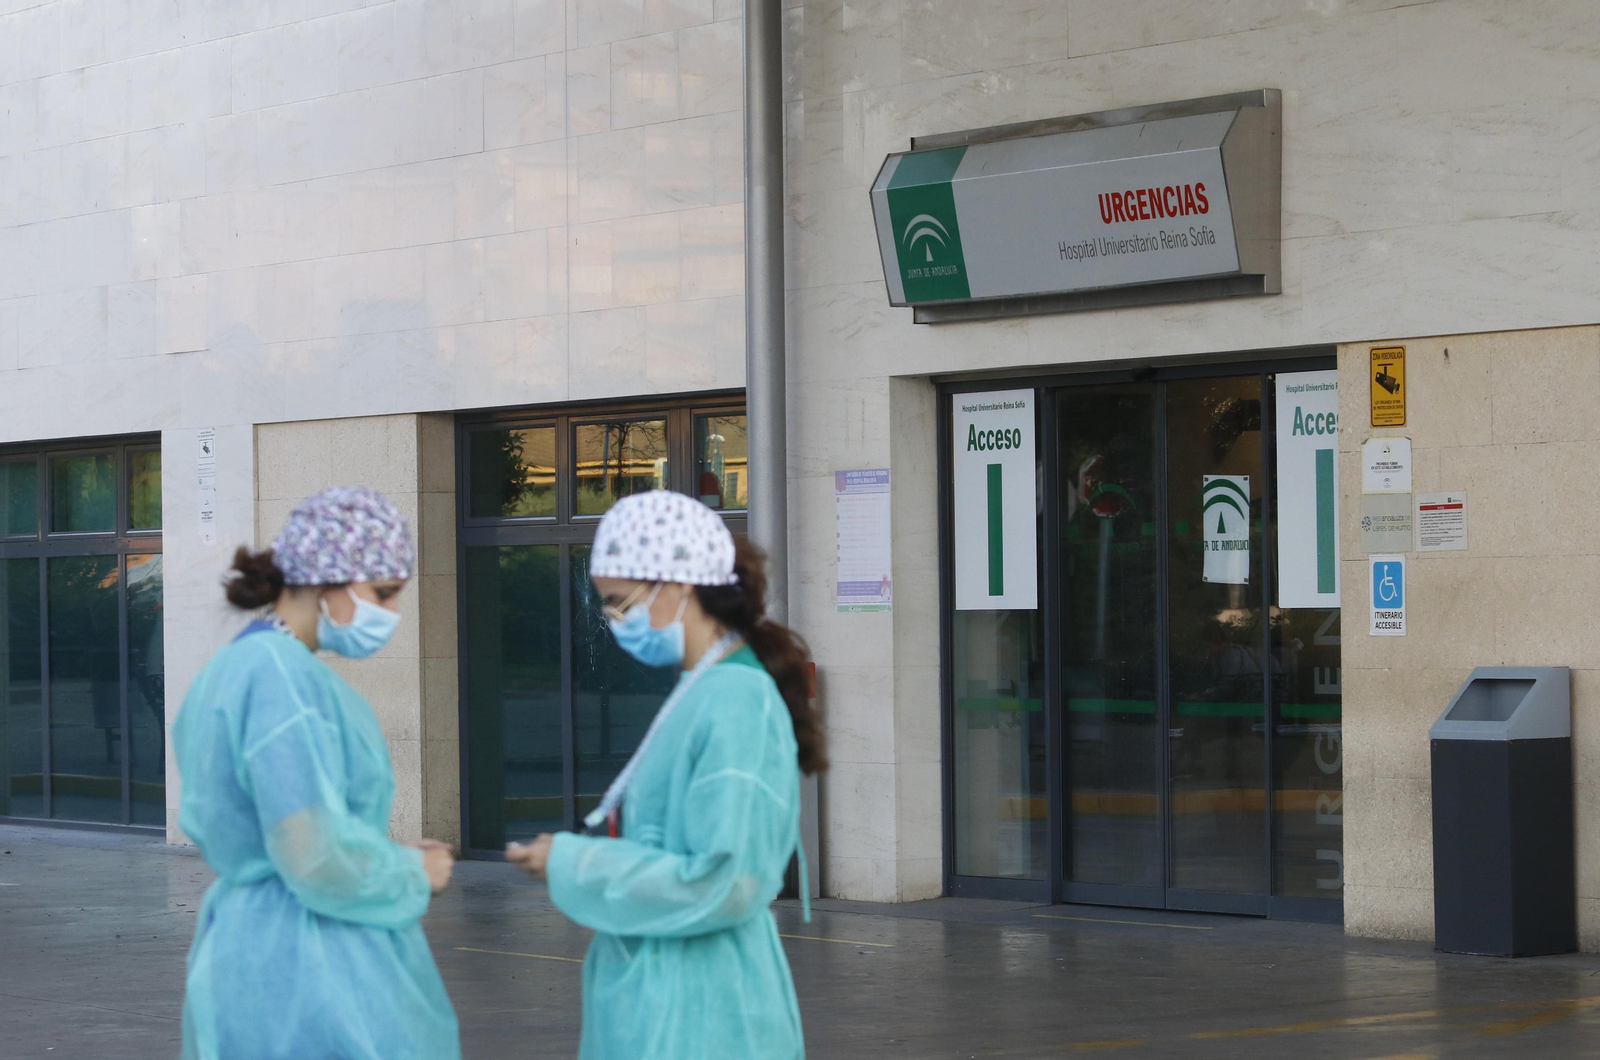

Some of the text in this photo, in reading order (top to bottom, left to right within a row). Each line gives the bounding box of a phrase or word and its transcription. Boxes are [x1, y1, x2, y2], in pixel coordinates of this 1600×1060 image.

[1098, 182, 1209, 224] URGENCIAS
[1058, 226, 1216, 262] Hospital Universitario Reina Sofía
[924, 267, 931, 278] DE
[1286, 384, 1304, 394] Hospital
[1305, 382, 1335, 392] Universitario
[962, 404, 978, 414] Hospital
[978, 402, 1002, 412] Universitario
[1003, 401, 1015, 410] Reina
[1292, 406, 1338, 436] Acce
[967, 424, 1021, 451] Acceso
[1211, 540, 1219, 551] DE
[1221, 539, 1249, 551] ANDALUCI
[1374, 611, 1403, 619] ITINERARIO
[1375, 621, 1402, 630] ACCESIBLE
